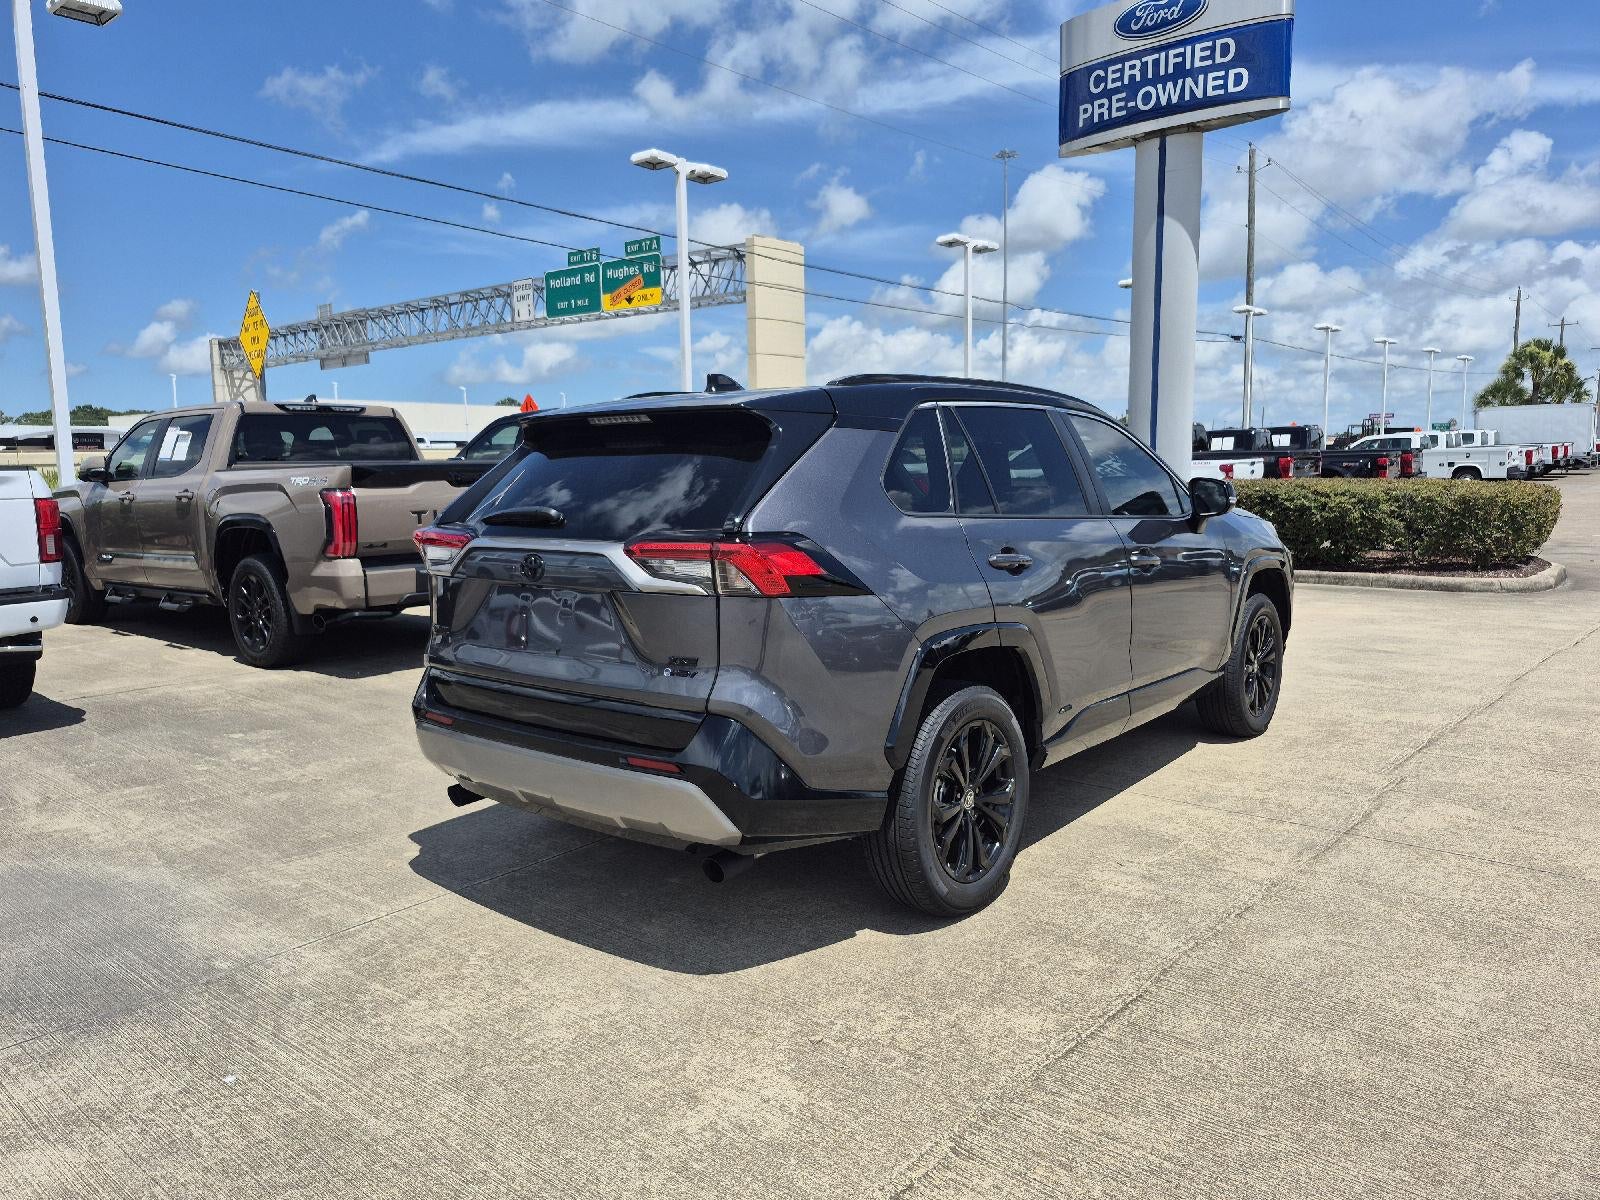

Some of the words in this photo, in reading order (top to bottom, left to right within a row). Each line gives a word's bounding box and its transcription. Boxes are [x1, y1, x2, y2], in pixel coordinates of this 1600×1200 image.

[1131, 0, 1184, 30] Ford
[1089, 37, 1236, 94] CERTIFIED
[1078, 67, 1249, 128] PRE-OWNED
[627, 243, 639, 253] EXIT
[642, 241, 650, 251] 17
[651, 239, 658, 250] A
[570, 255, 581, 263] EXIT
[583, 252, 591, 262] 17
[607, 263, 640, 280] Hughes
[643, 260, 655, 274] Rd
[514, 283, 532, 292] SPEED
[550, 272, 581, 289] Holland
[584, 271, 596, 284] Rd
[623, 278, 642, 294] CLOSED
[516, 293, 531, 303] LIMIT
[557, 301, 568, 310] EXIT
[570, 299, 576, 309] 1
[577, 298, 590, 307] MILE
[637, 293, 655, 302] ONLY
